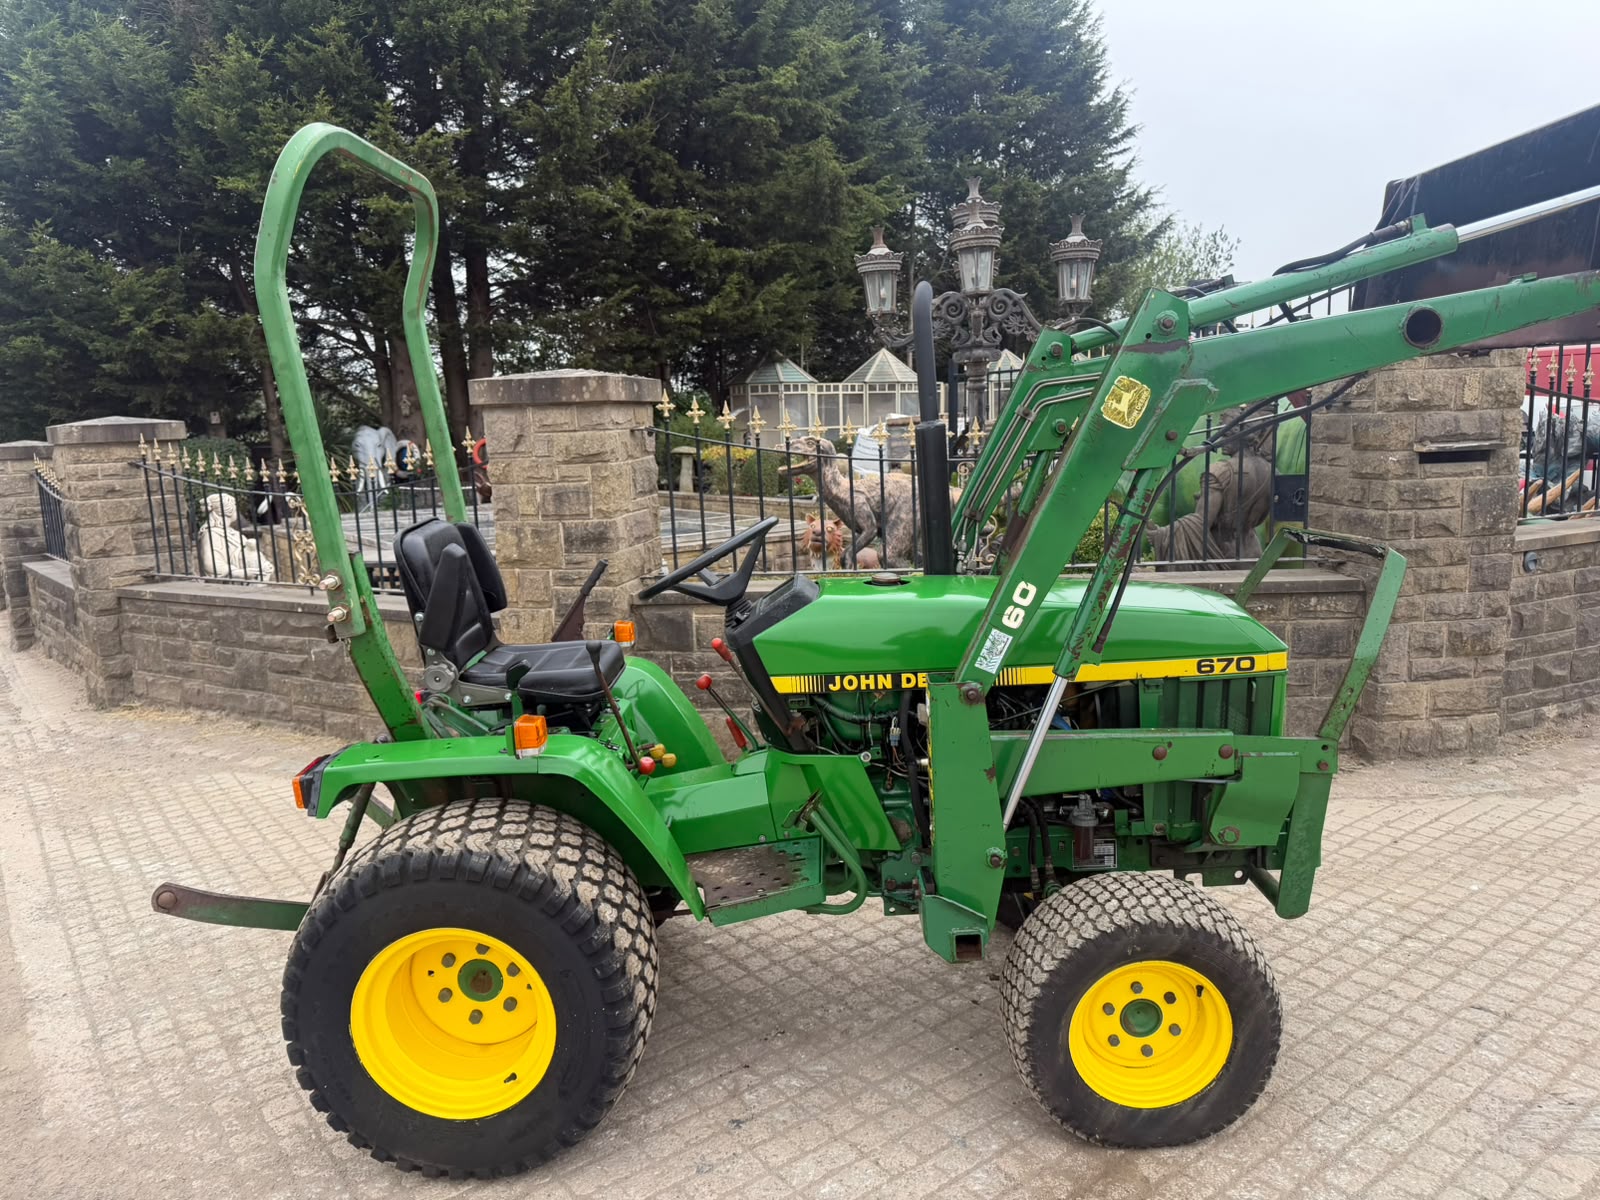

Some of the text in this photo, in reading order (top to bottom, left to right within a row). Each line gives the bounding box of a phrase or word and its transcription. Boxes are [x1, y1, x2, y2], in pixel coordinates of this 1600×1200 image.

[1002, 581, 1037, 629] 60
[1197, 656, 1256, 674] 670
[828, 673, 893, 692] JOHN
